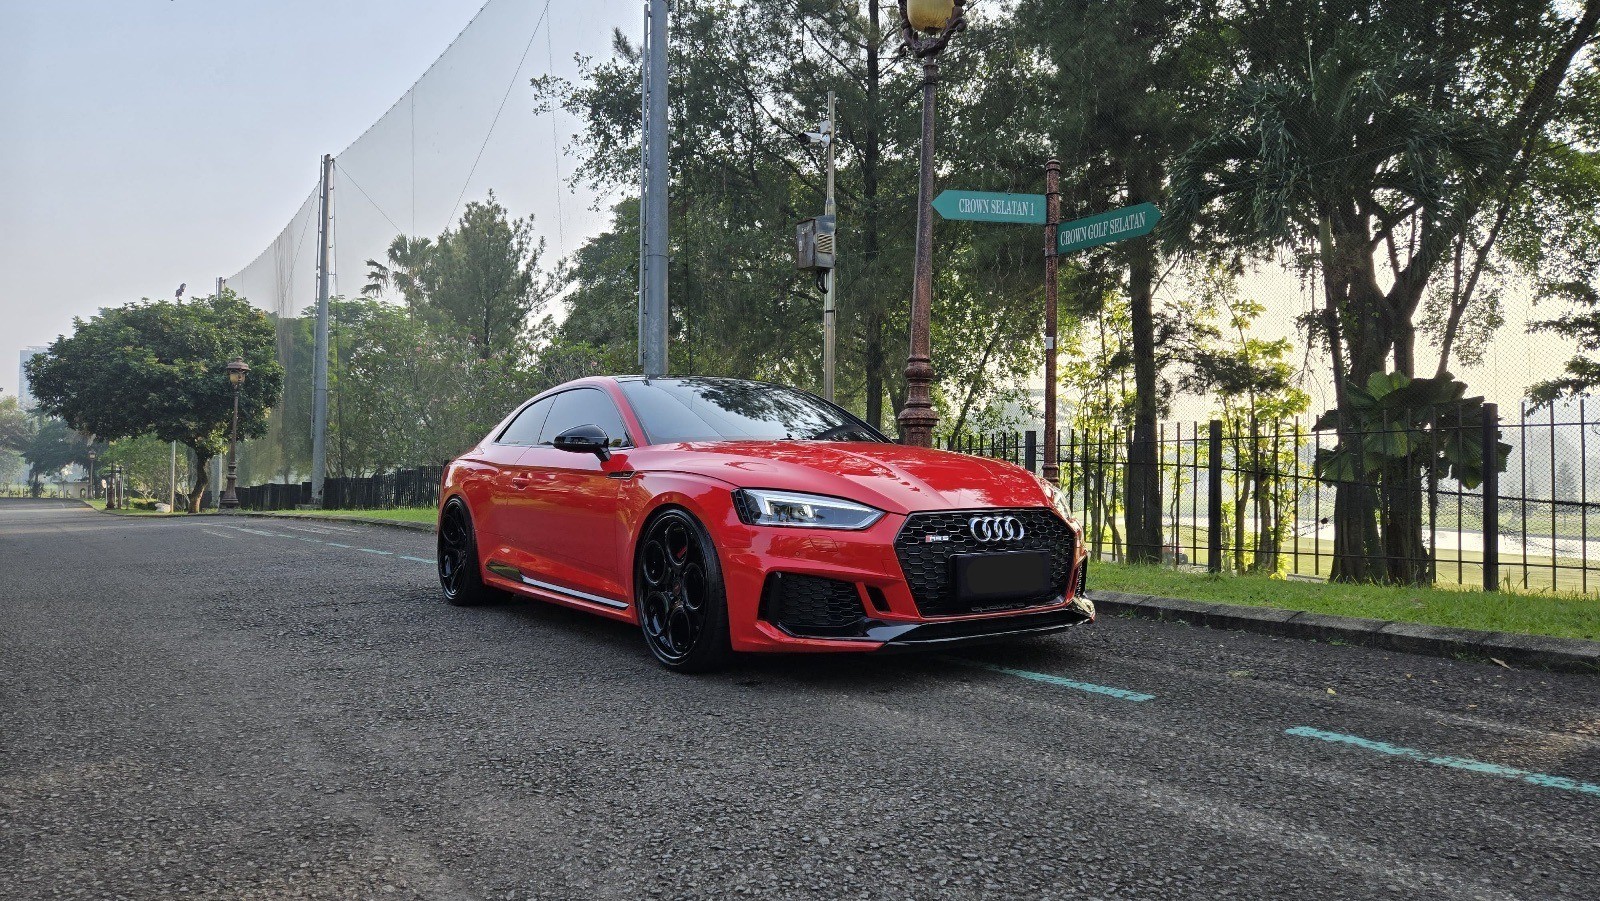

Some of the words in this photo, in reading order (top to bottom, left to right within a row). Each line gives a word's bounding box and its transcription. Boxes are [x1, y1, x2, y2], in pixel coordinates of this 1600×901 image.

[958, 198, 989, 214] CROWN
[991, 199, 1029, 216] SELATAN
[1030, 202, 1035, 216] 1
[1060, 226, 1087, 246] CROWN
[1087, 221, 1109, 240] GOLF
[1109, 211, 1146, 235] SELATAN
